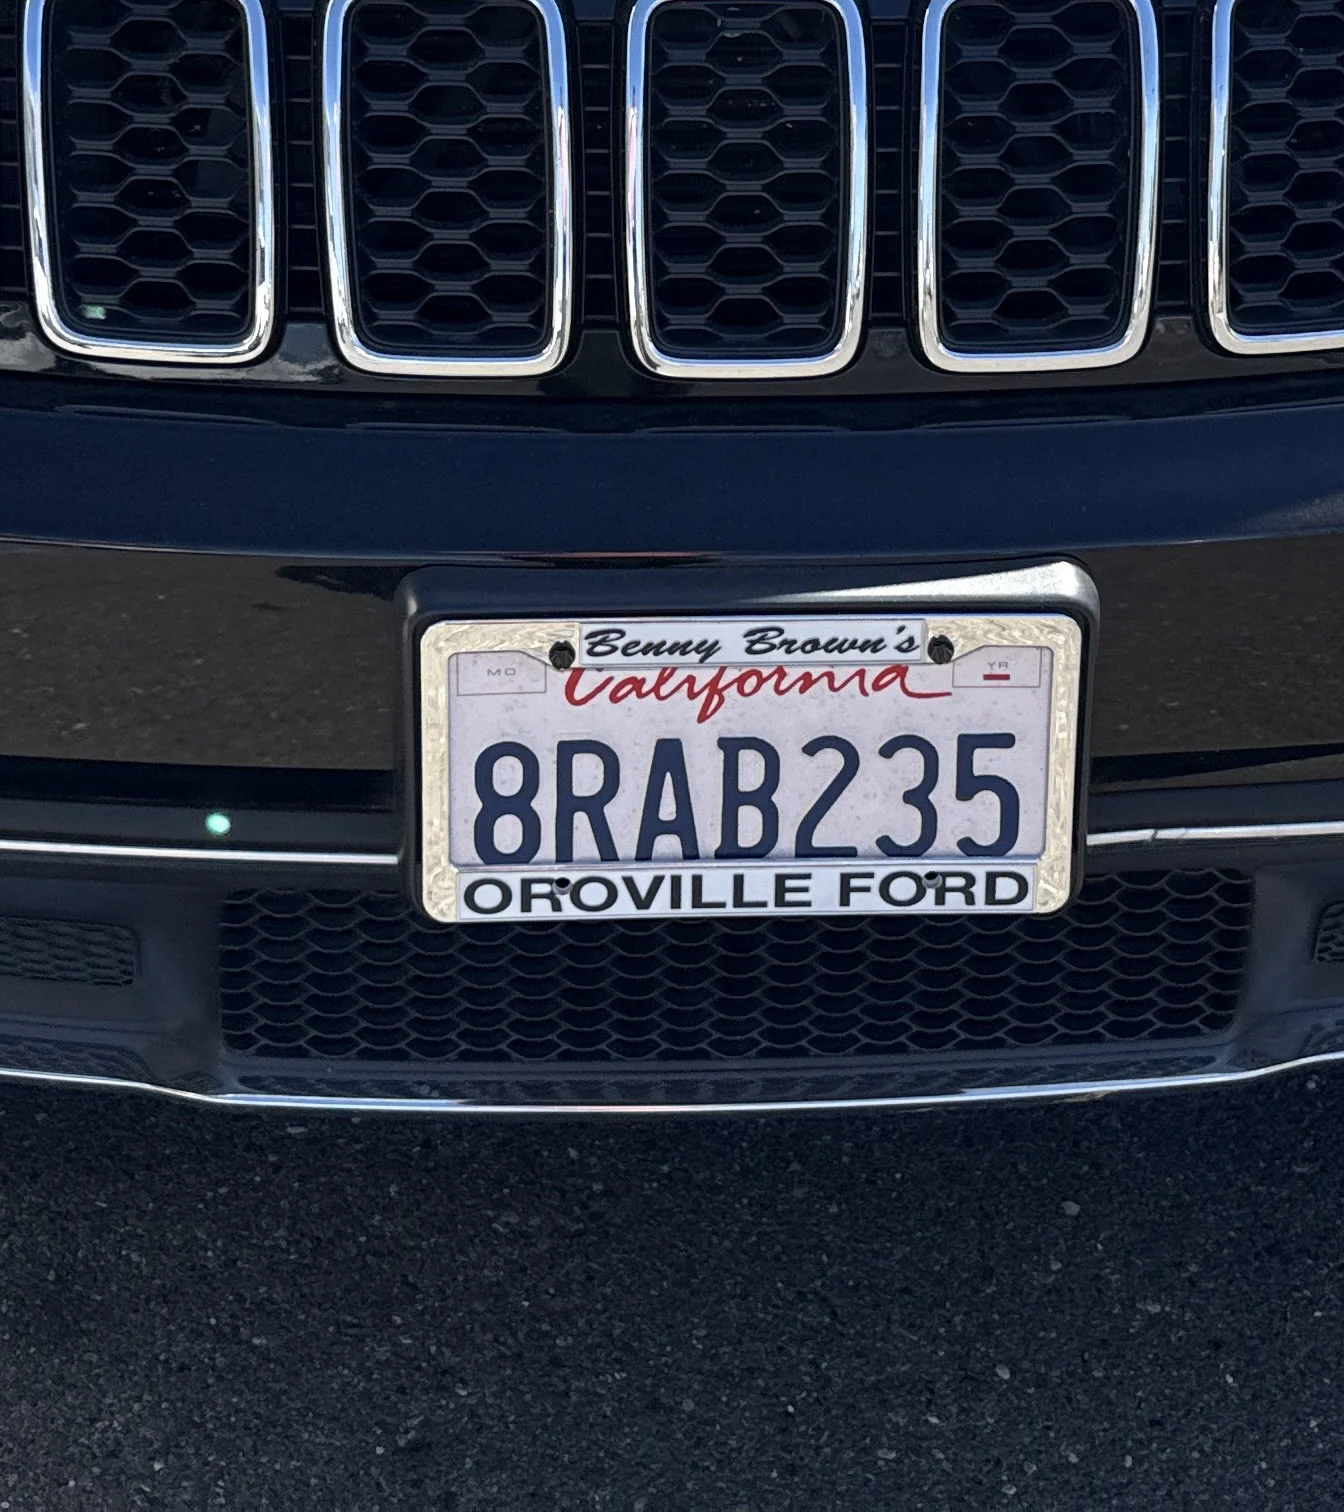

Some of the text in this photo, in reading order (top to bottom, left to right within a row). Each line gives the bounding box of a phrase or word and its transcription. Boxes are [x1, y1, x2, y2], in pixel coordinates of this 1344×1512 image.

[584, 625, 922, 664] Benny Brown's
[486, 667, 517, 677] MO
[564, 664, 953, 724] California
[472, 732, 1021, 866] 8RAB235
[463, 871, 1030, 915] OROVILLE FORD
